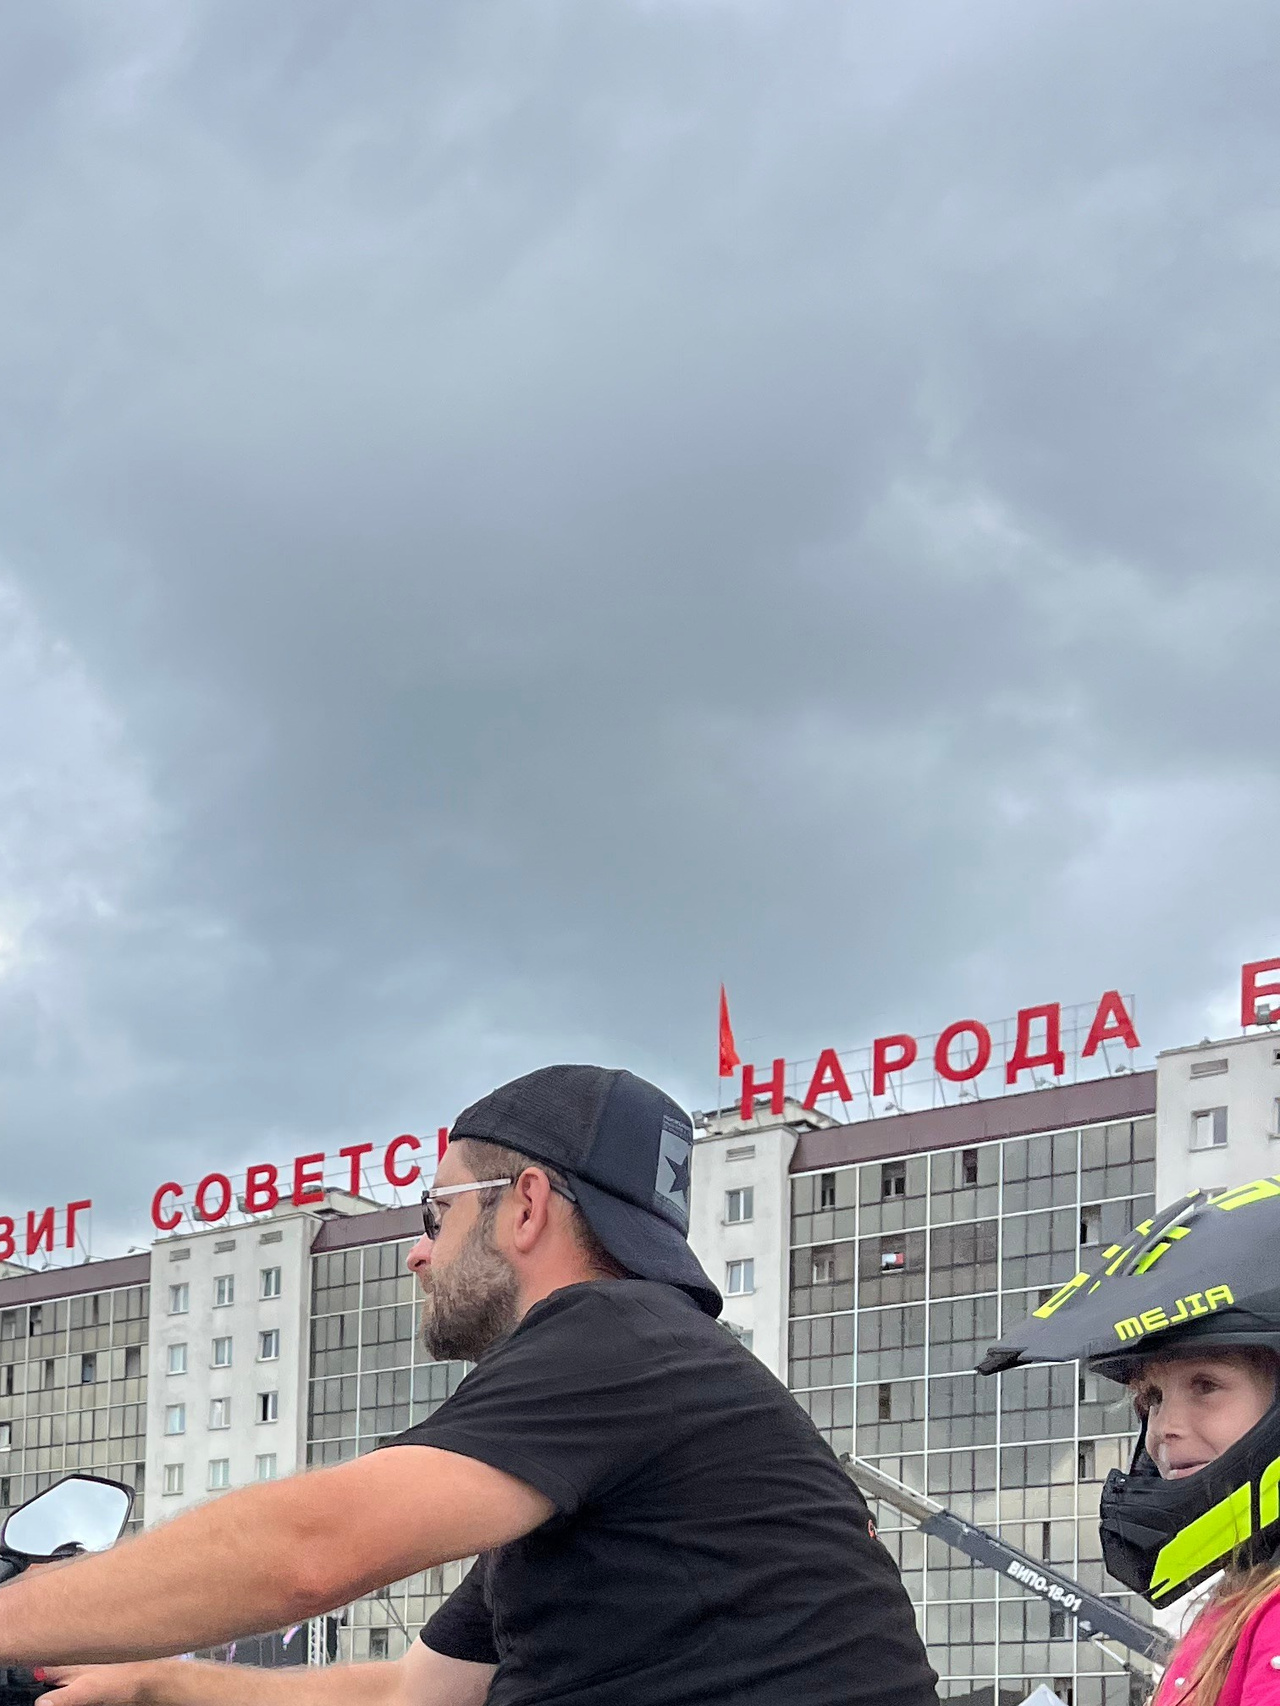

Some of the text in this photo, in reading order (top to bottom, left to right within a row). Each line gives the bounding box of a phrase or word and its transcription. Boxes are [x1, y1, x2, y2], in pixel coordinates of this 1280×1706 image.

[151, 1127, 448, 1230] СОВЕТС
[740, 989, 1141, 1120] НАРОДА
[1007, 1560, 1082, 1612] ВИПО-18-01
